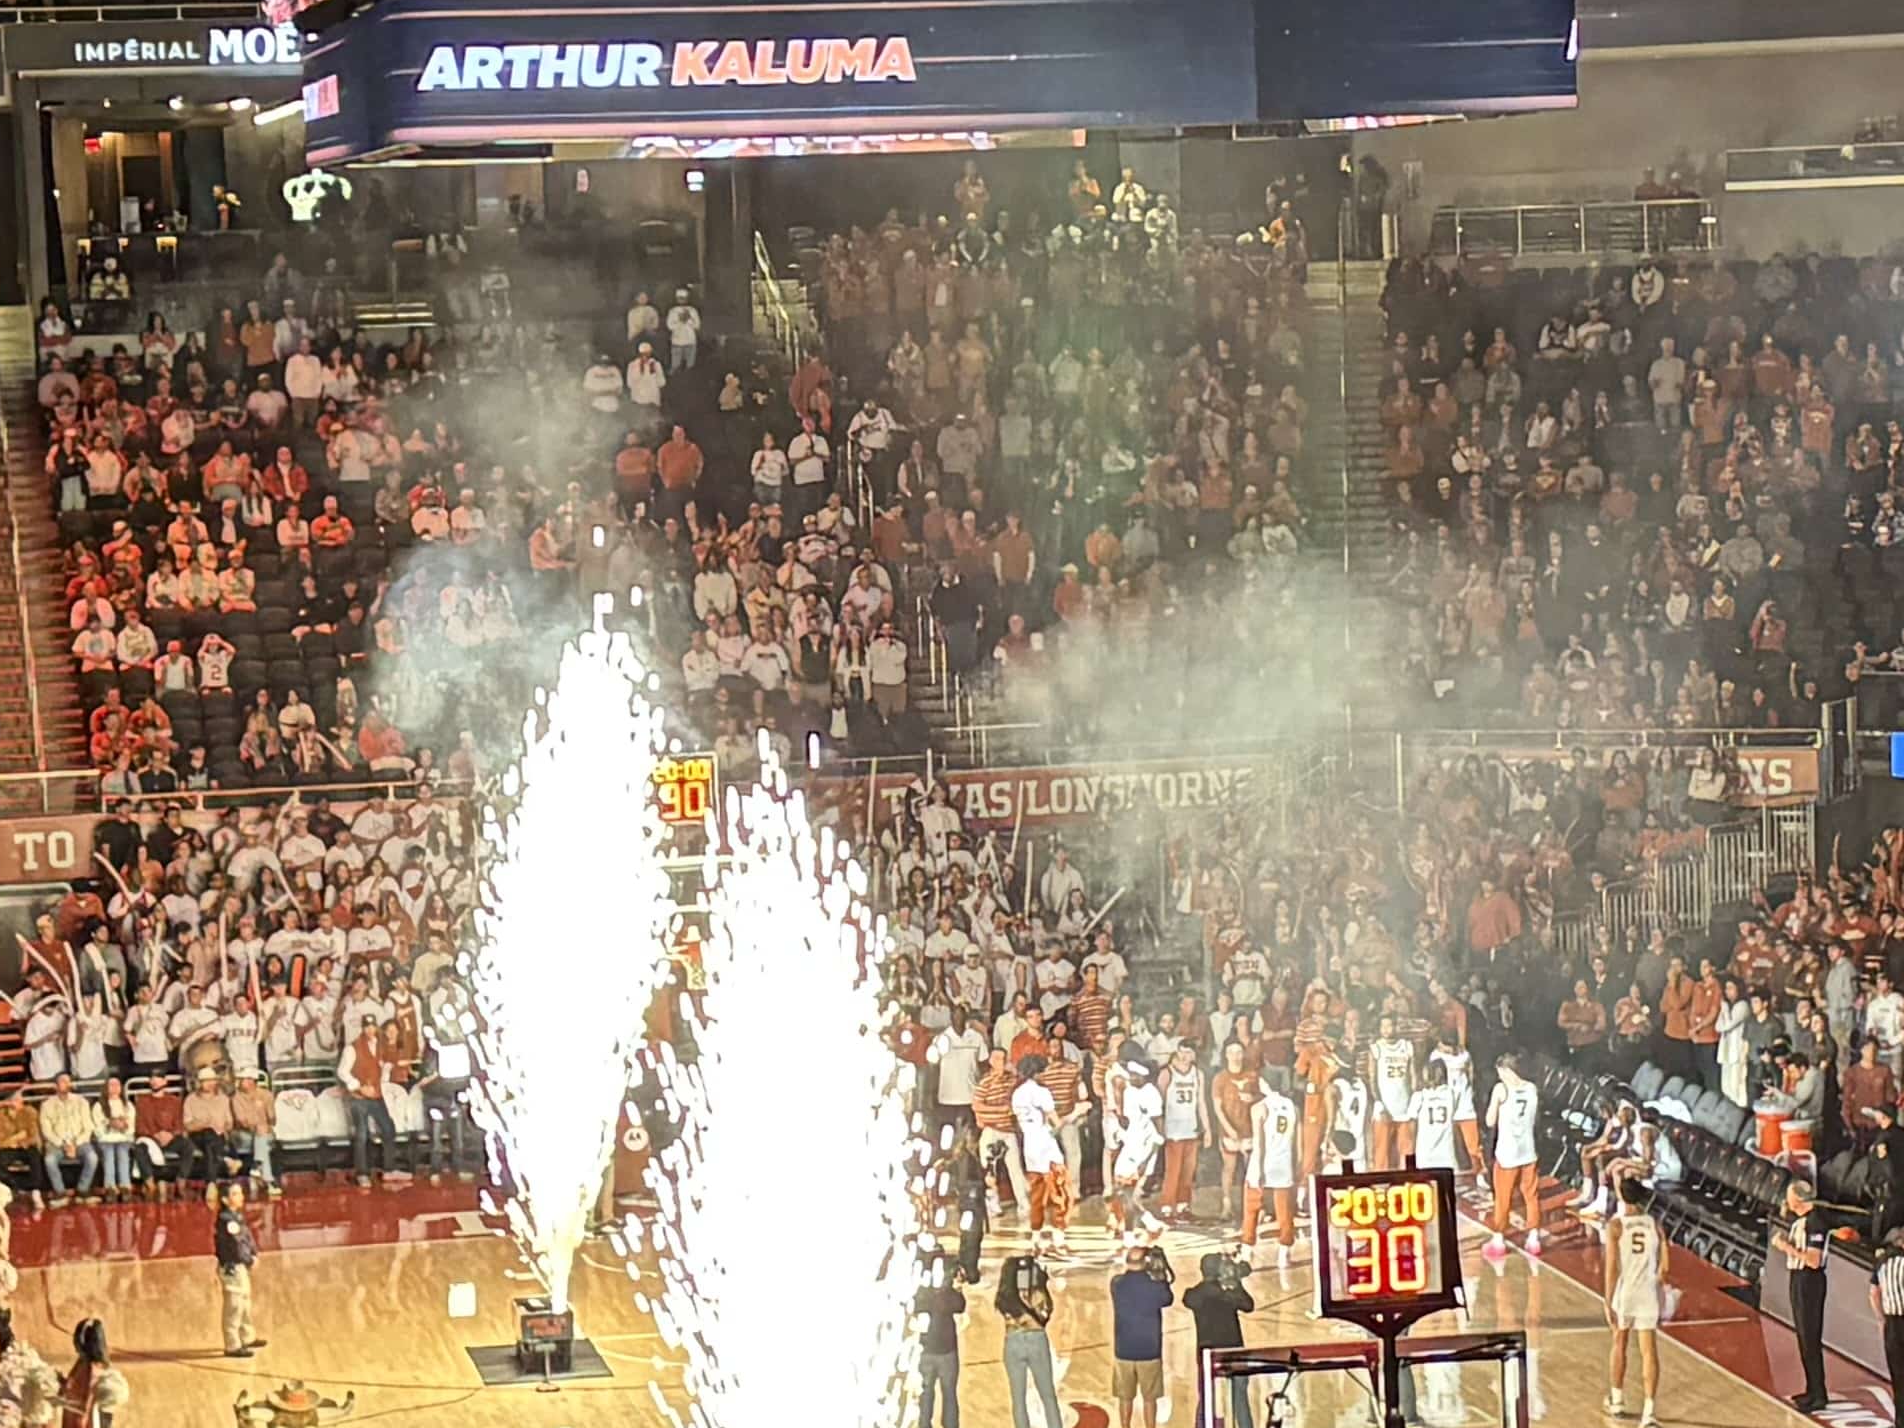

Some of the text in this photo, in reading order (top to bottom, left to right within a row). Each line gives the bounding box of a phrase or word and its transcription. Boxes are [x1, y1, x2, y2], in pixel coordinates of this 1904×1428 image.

[208, 24, 302, 66] MOË
[416, 35, 919, 92] ARTHUR KALUMA
[210, 664, 223, 682] 2
[14, 832, 75, 867] TO
[1426, 1106, 1447, 1125] 13
[1515, 1099, 1528, 1117] 7
[1329, 1182, 1434, 1227] 20:00
[1346, 1225, 1426, 1294] 30
[1631, 1232, 1646, 1255] 5
